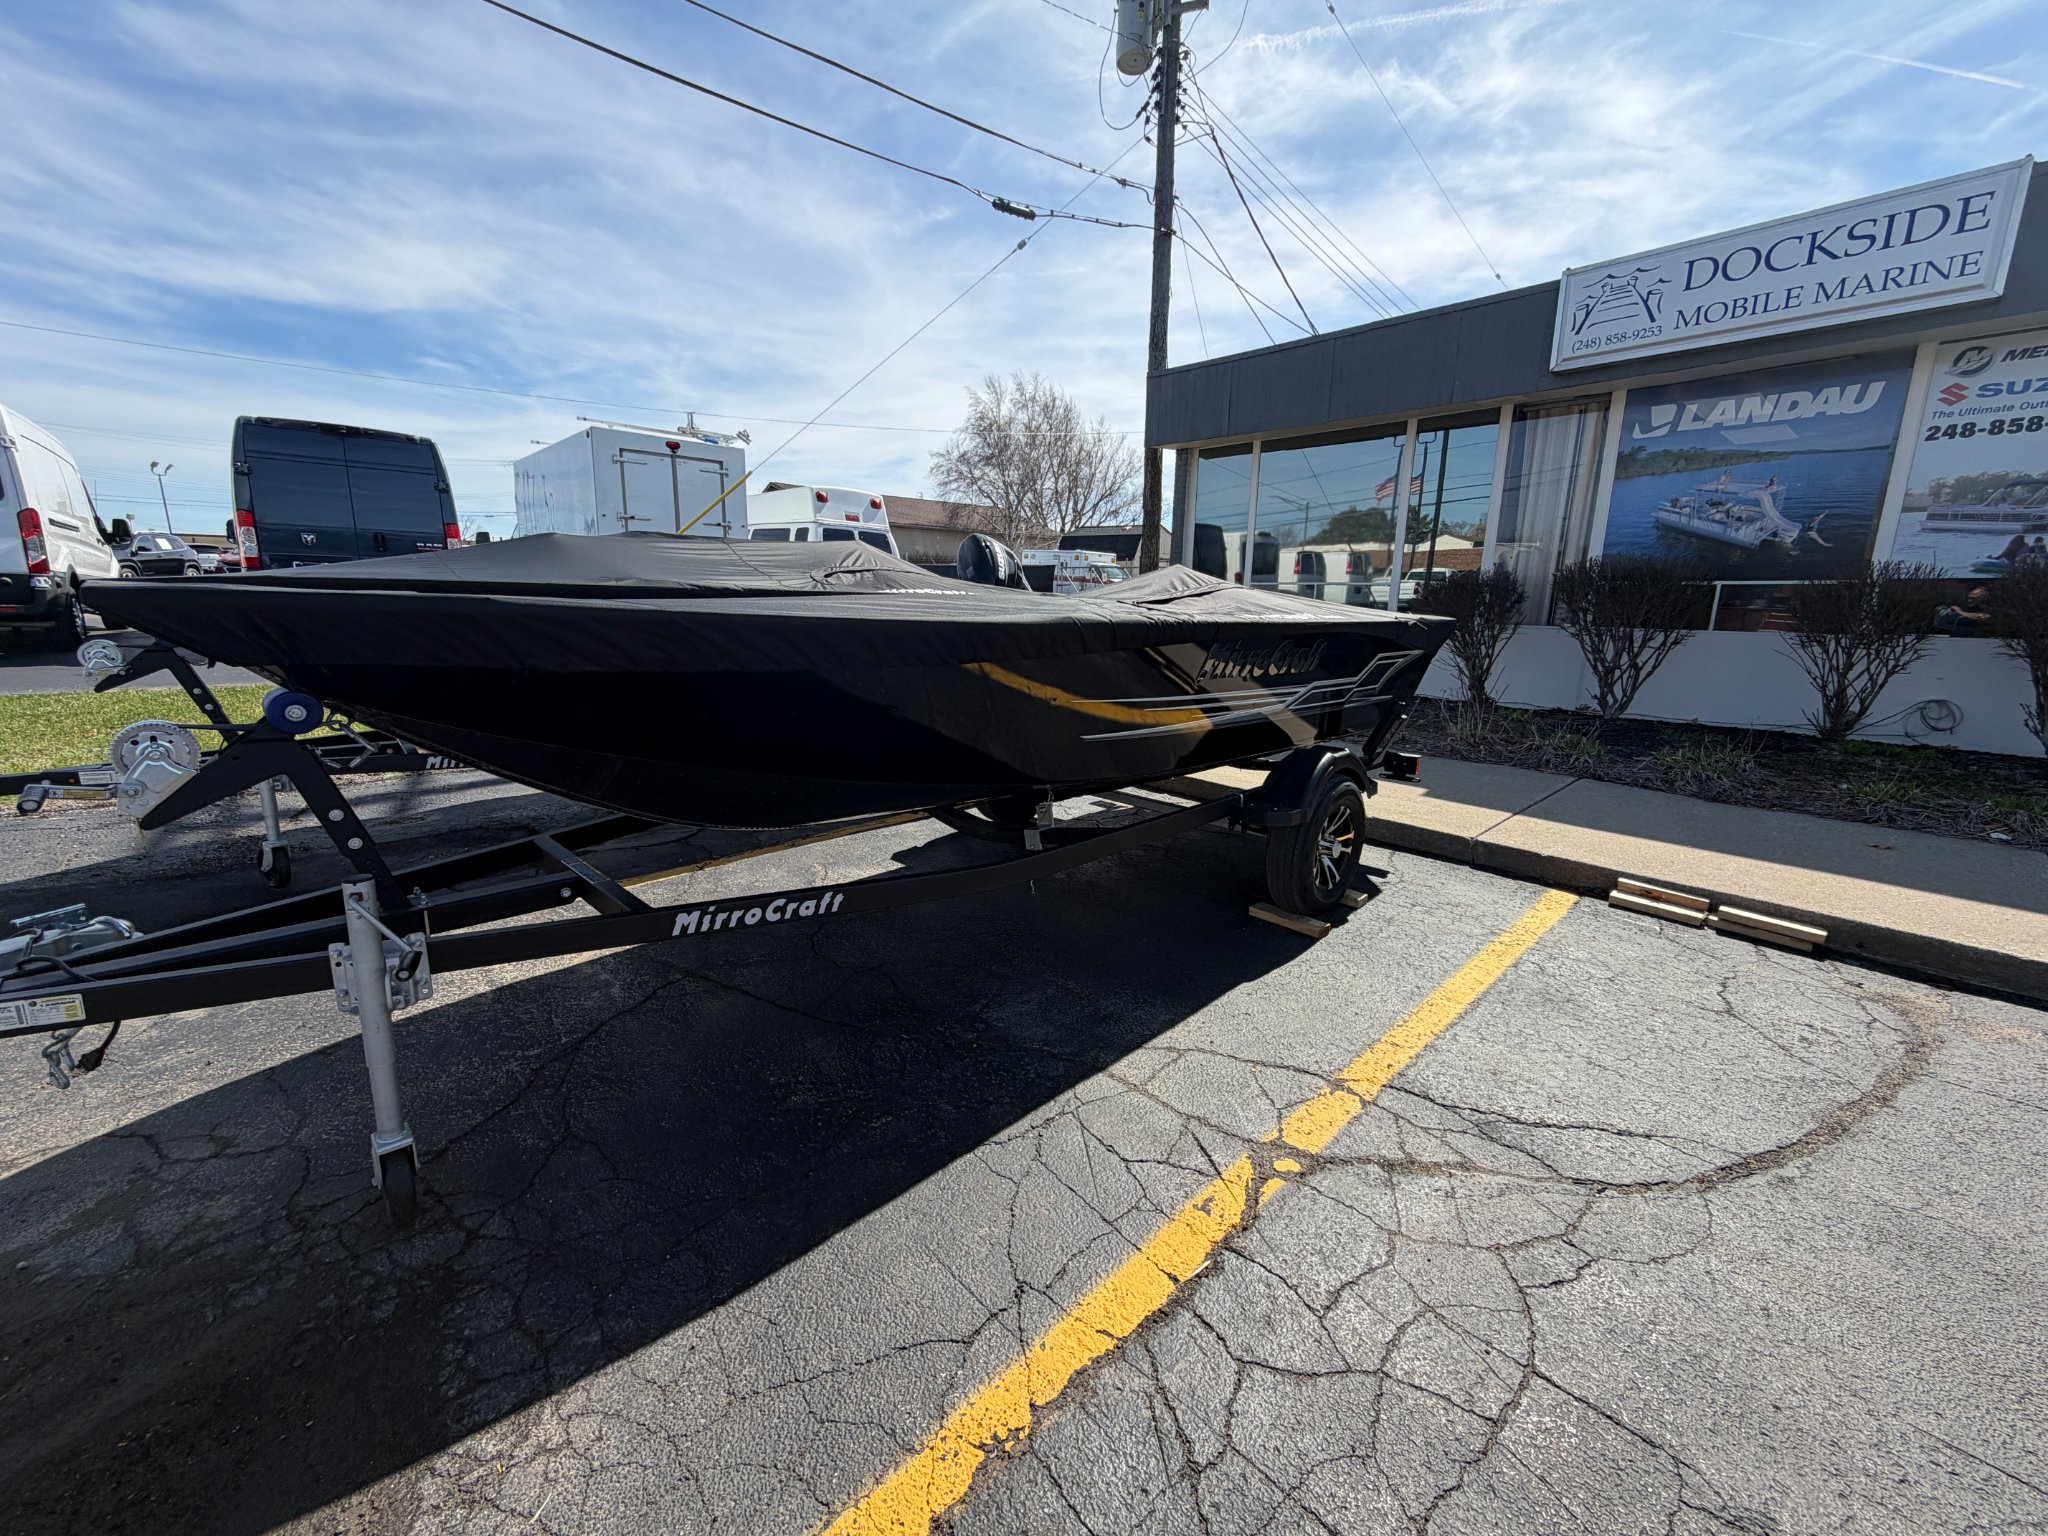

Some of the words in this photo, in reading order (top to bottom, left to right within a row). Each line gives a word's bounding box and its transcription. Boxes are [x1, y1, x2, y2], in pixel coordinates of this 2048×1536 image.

[1682, 190, 1997, 293] DOCKSIDE
[1673, 285, 1804, 330] MOBILE
[1811, 250, 1985, 304] MARINE
[1571, 336, 1602, 354] (248)
[1604, 325, 1663, 346] 858-9253
[2000, 345, 2048, 363] ME
[1676, 381, 1887, 432] LANDAU
[1931, 411, 1955, 420] The
[1958, 404, 2016, 417] Ultimate
[672, 891, 845, 937] MirroCraft
